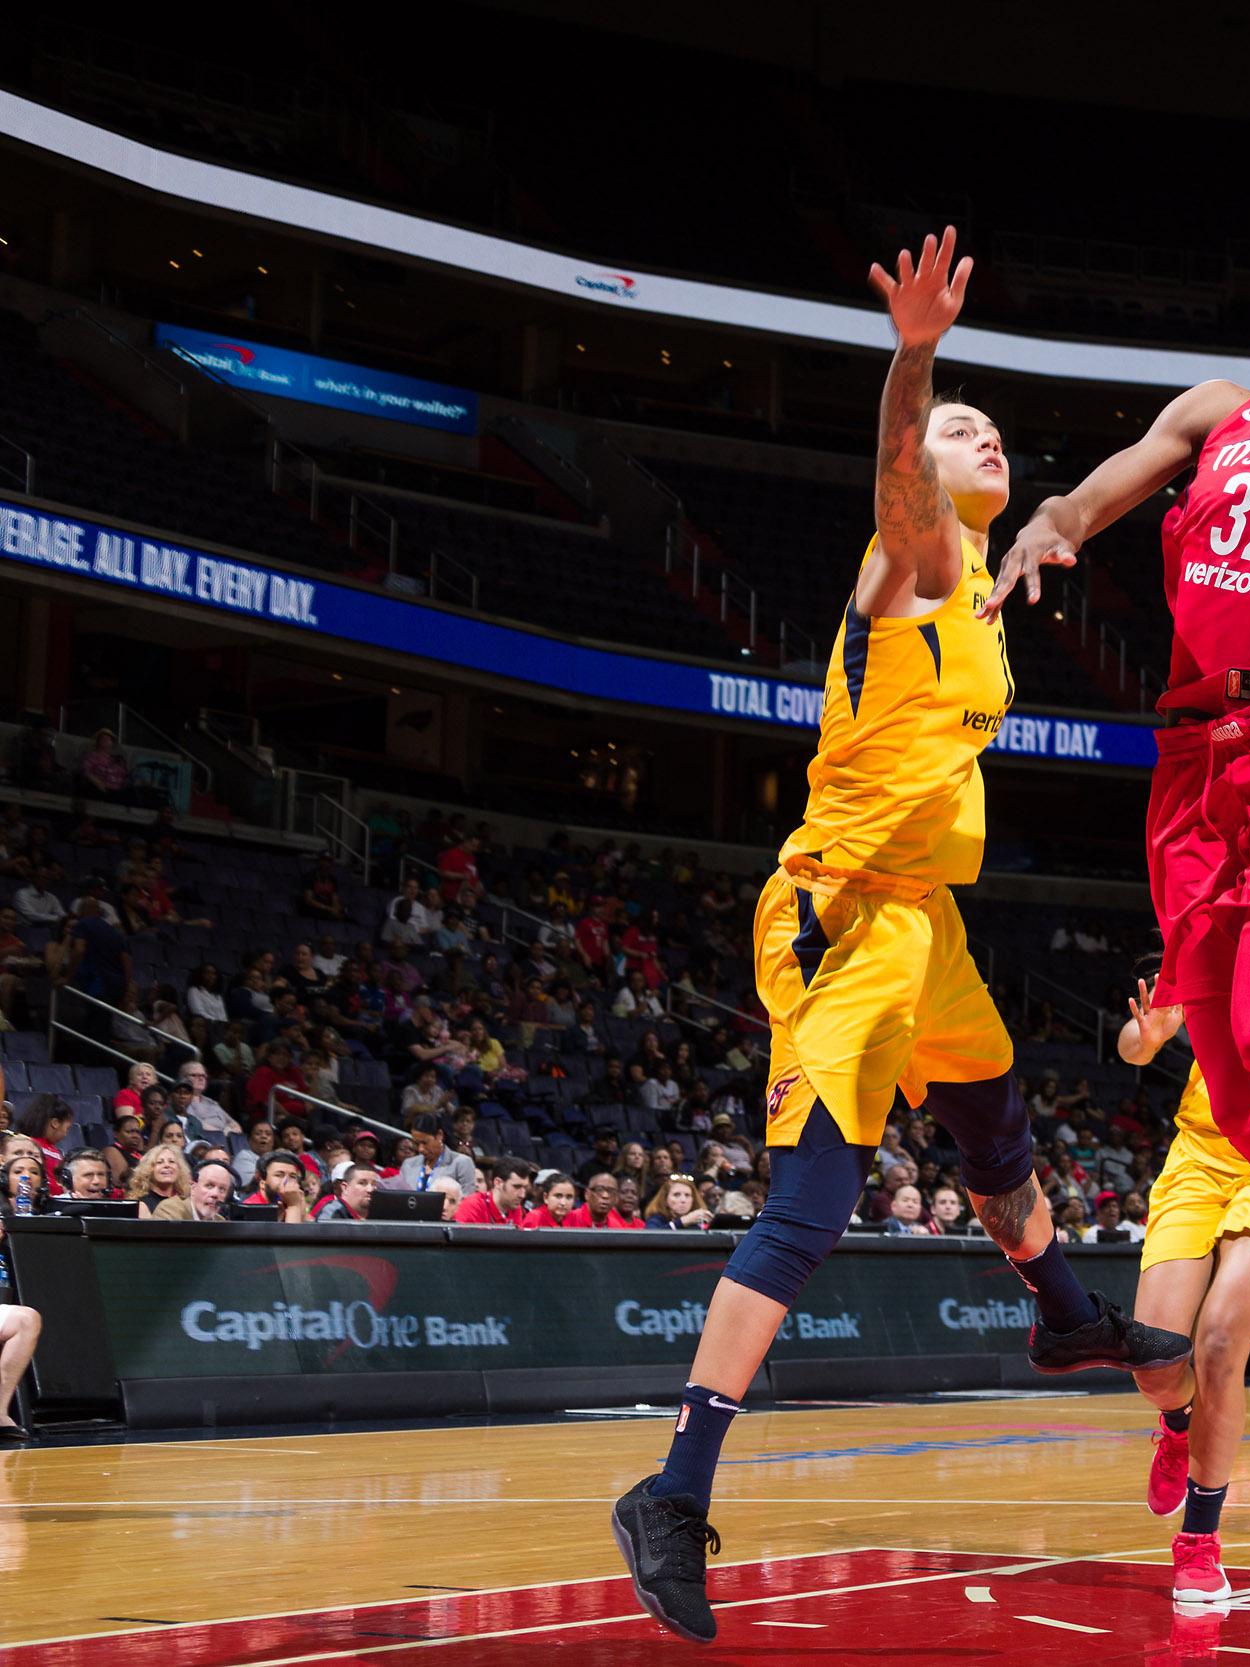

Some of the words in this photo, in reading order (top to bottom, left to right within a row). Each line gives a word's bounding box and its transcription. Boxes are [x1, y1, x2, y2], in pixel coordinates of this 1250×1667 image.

[93, 531, 138, 583] ALL
[140, 542, 193, 595] DAY.
[196, 556, 268, 612] EVERY
[269, 574, 319, 625] DAY.
[709, 674, 769, 714] TOTAL
[990, 714, 1050, 756] VERY
[1052, 722, 1102, 758] DAY.
[424, 1315, 509, 1346] Bank
[797, 1312, 861, 1339] Bank
